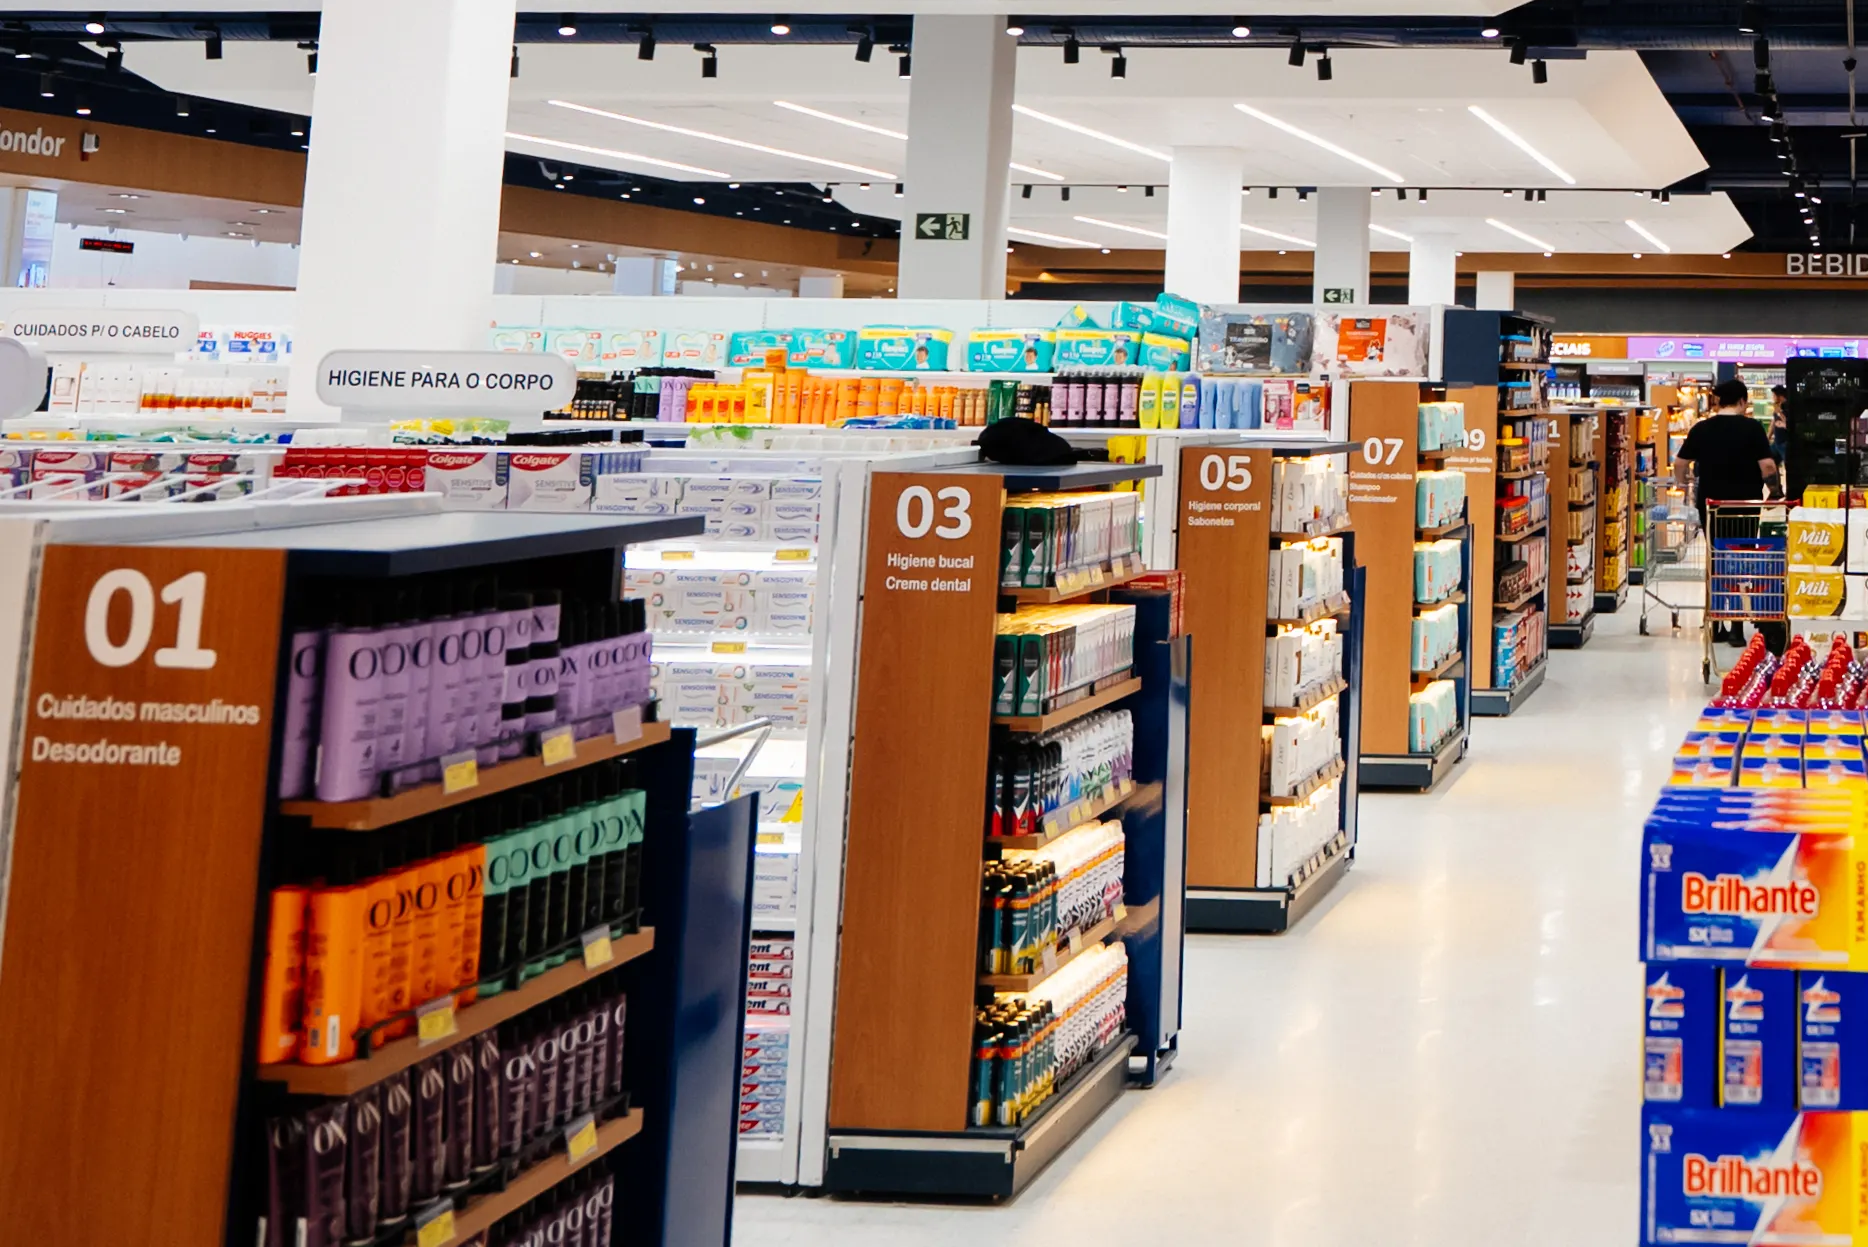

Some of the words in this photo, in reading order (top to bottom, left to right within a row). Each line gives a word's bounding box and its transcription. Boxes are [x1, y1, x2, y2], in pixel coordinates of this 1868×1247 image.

[0, 124, 66, 157] ondor
[13, 323, 88, 337] CUIDADOS
[91, 324, 105, 337] P/
[107, 325, 118, 337] O
[122, 325, 180, 338] CABELO
[328, 370, 406, 388] HIGIENE
[411, 372, 460, 389] PARA
[466, 373, 479, 389] O
[485, 374, 554, 390] CORPO
[428, 454, 476, 466] Colgate
[512, 454, 559, 467] Colgate
[1363, 437, 1404, 465] 07
[1200, 454, 1252, 491] 05
[1349, 482, 1380, 492] Shampoo
[1188, 501, 1222, 512] Higiene
[1224, 502, 1261, 512] corporal
[1349, 494, 1398, 503] Condicionador
[896, 485, 972, 539] 03
[1188, 516, 1235, 526] Sabonetes
[1797, 529, 1831, 545] Mili
[887, 553, 936, 571] Higiene
[939, 554, 974, 569] bucal
[886, 576, 928, 591] Creme
[930, 577, 971, 592] dental
[1795, 580, 1830, 597] Mili
[84, 568, 217, 669] 01
[36, 693, 136, 722] Cuidados
[139, 699, 260, 725] masculinos
[31, 736, 182, 766] Desodorante
[1684, 875, 1818, 914] Brilhante
[1856, 860, 1867, 942] TAMANHO
[1686, 1158, 1820, 1196] Brilhante
